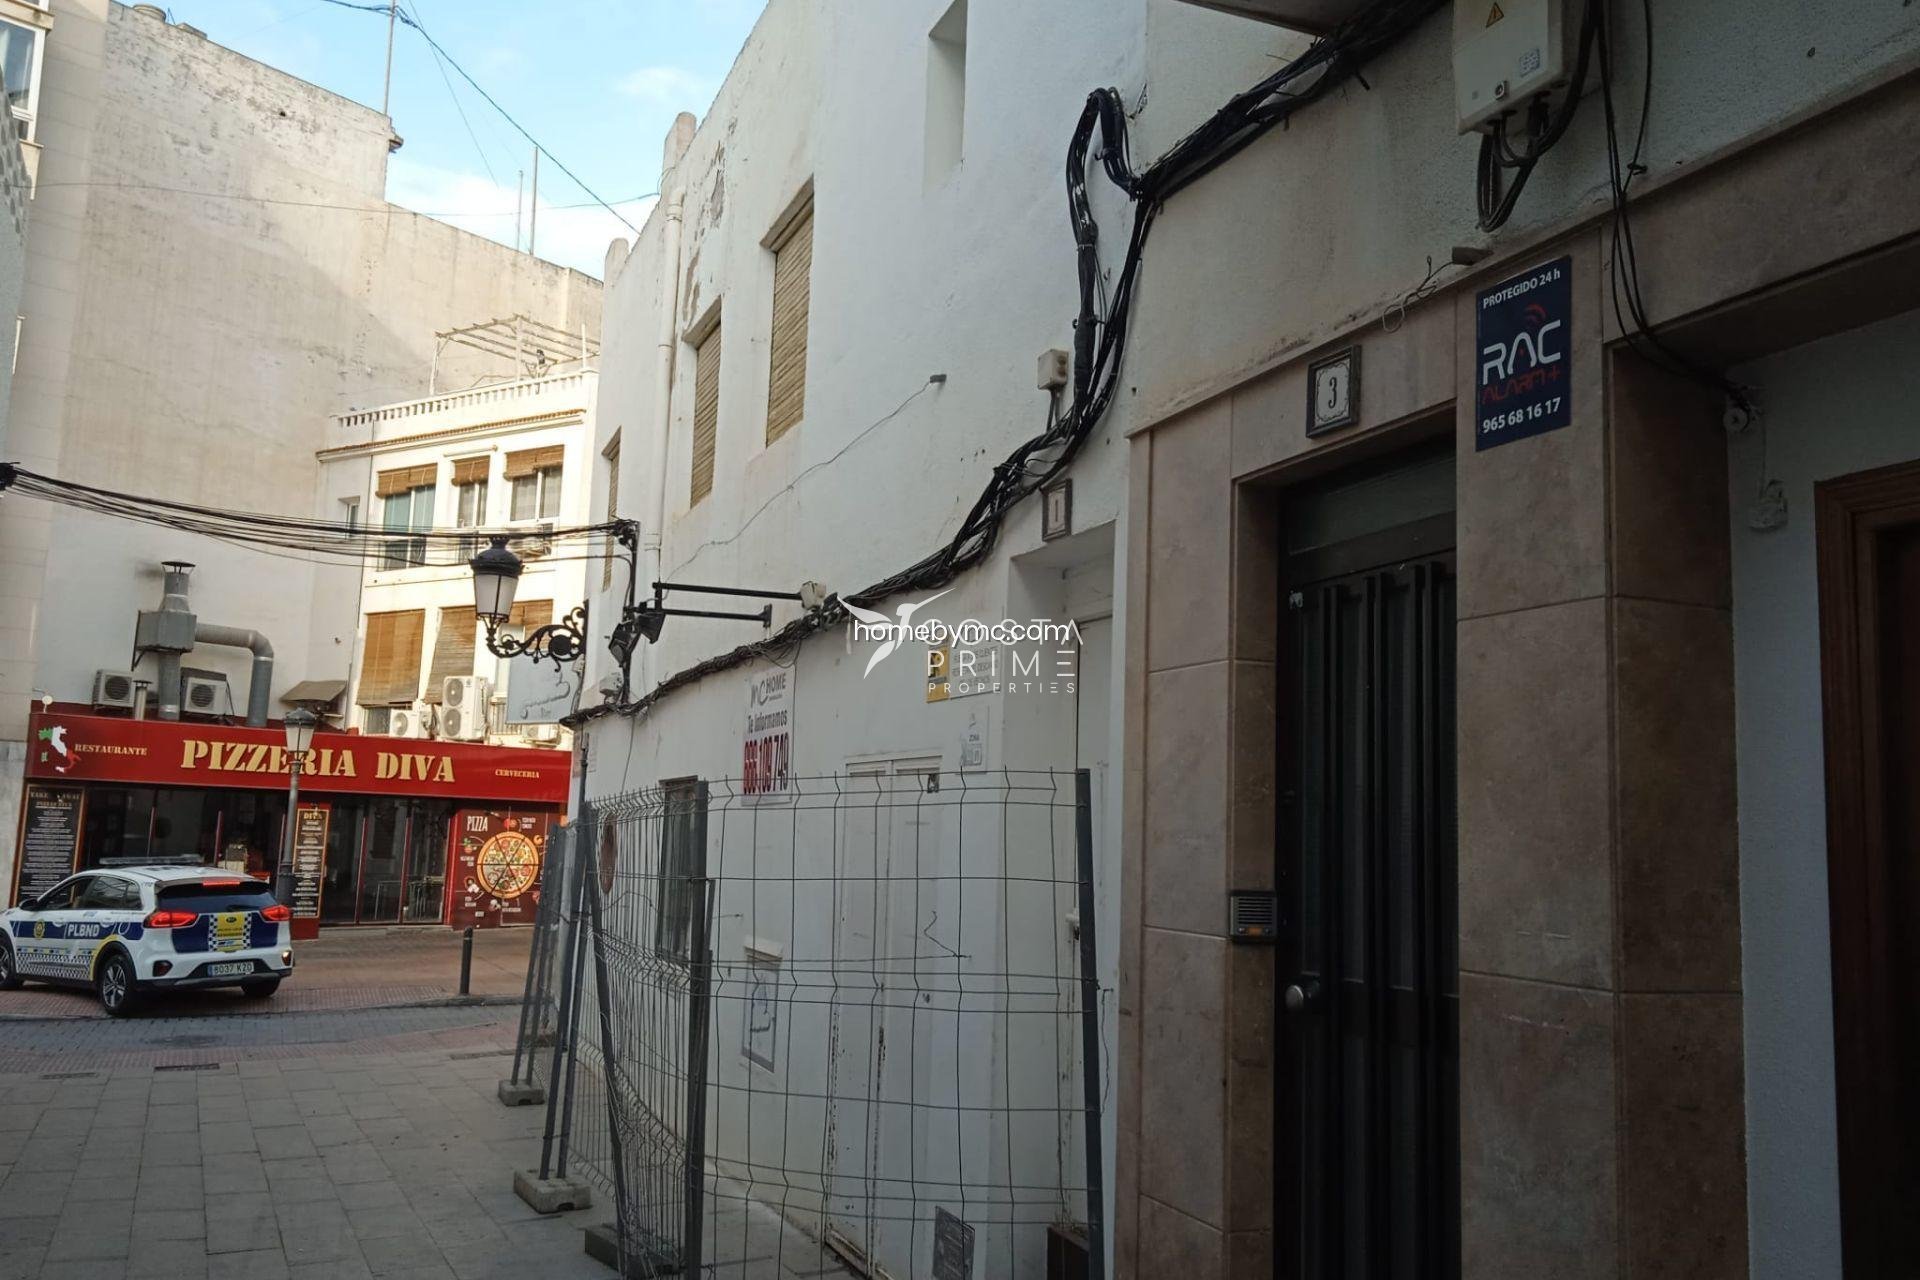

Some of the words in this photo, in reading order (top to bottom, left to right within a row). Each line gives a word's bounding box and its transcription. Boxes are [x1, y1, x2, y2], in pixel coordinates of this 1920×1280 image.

[1482, 277, 1537, 309] PROTEGIDO
[1539, 271, 1553, 286] 24
[1553, 268, 1561, 281] h
[1482, 319, 1561, 386] RAC
[1328, 377, 1338, 409] 3
[1482, 414, 1506, 434] 965
[1508, 408, 1524, 426] 68
[1526, 403, 1542, 420] 16
[1545, 397, 1561, 415] 17
[766, 671, 787, 694] HOME
[74, 743, 147, 756] RESTAURANTE
[180, 738, 357, 777] PIZZERIA
[375, 752, 455, 783] DIVA
[495, 768, 540, 779] CERVECERIA
[466, 815, 488, 832] PIZZA
[67, 923, 100, 937] PLBND
